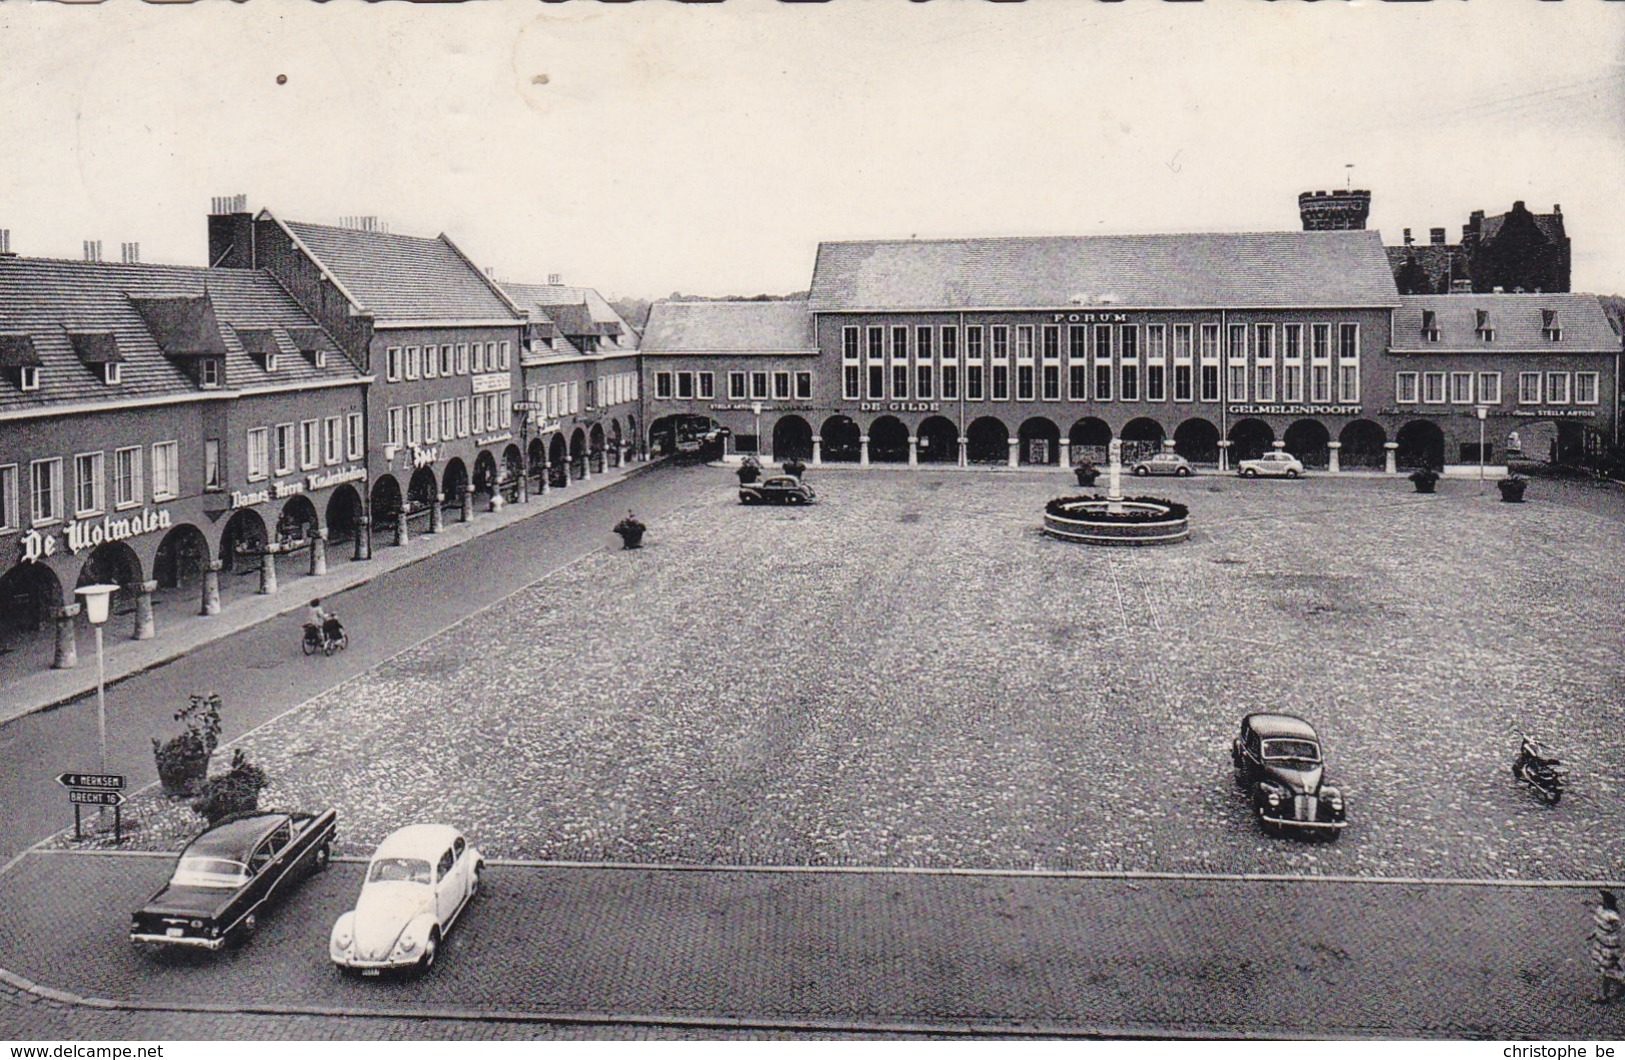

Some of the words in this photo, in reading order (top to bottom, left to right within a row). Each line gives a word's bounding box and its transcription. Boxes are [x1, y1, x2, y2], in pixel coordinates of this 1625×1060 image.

[1054, 313, 1127, 322] FORUM
[860, 402, 881, 412] DE
[888, 402, 940, 412] GILDE
[1229, 405, 1363, 415] GELMELENPOORT
[231, 489, 270, 509] Dames
[22, 528, 56, 563] De
[69, 776, 75, 785] 4
[80, 776, 119, 787] MERKSEM
[71, 792, 102, 802] BRECHT
[107, 794, 117, 804] 16
